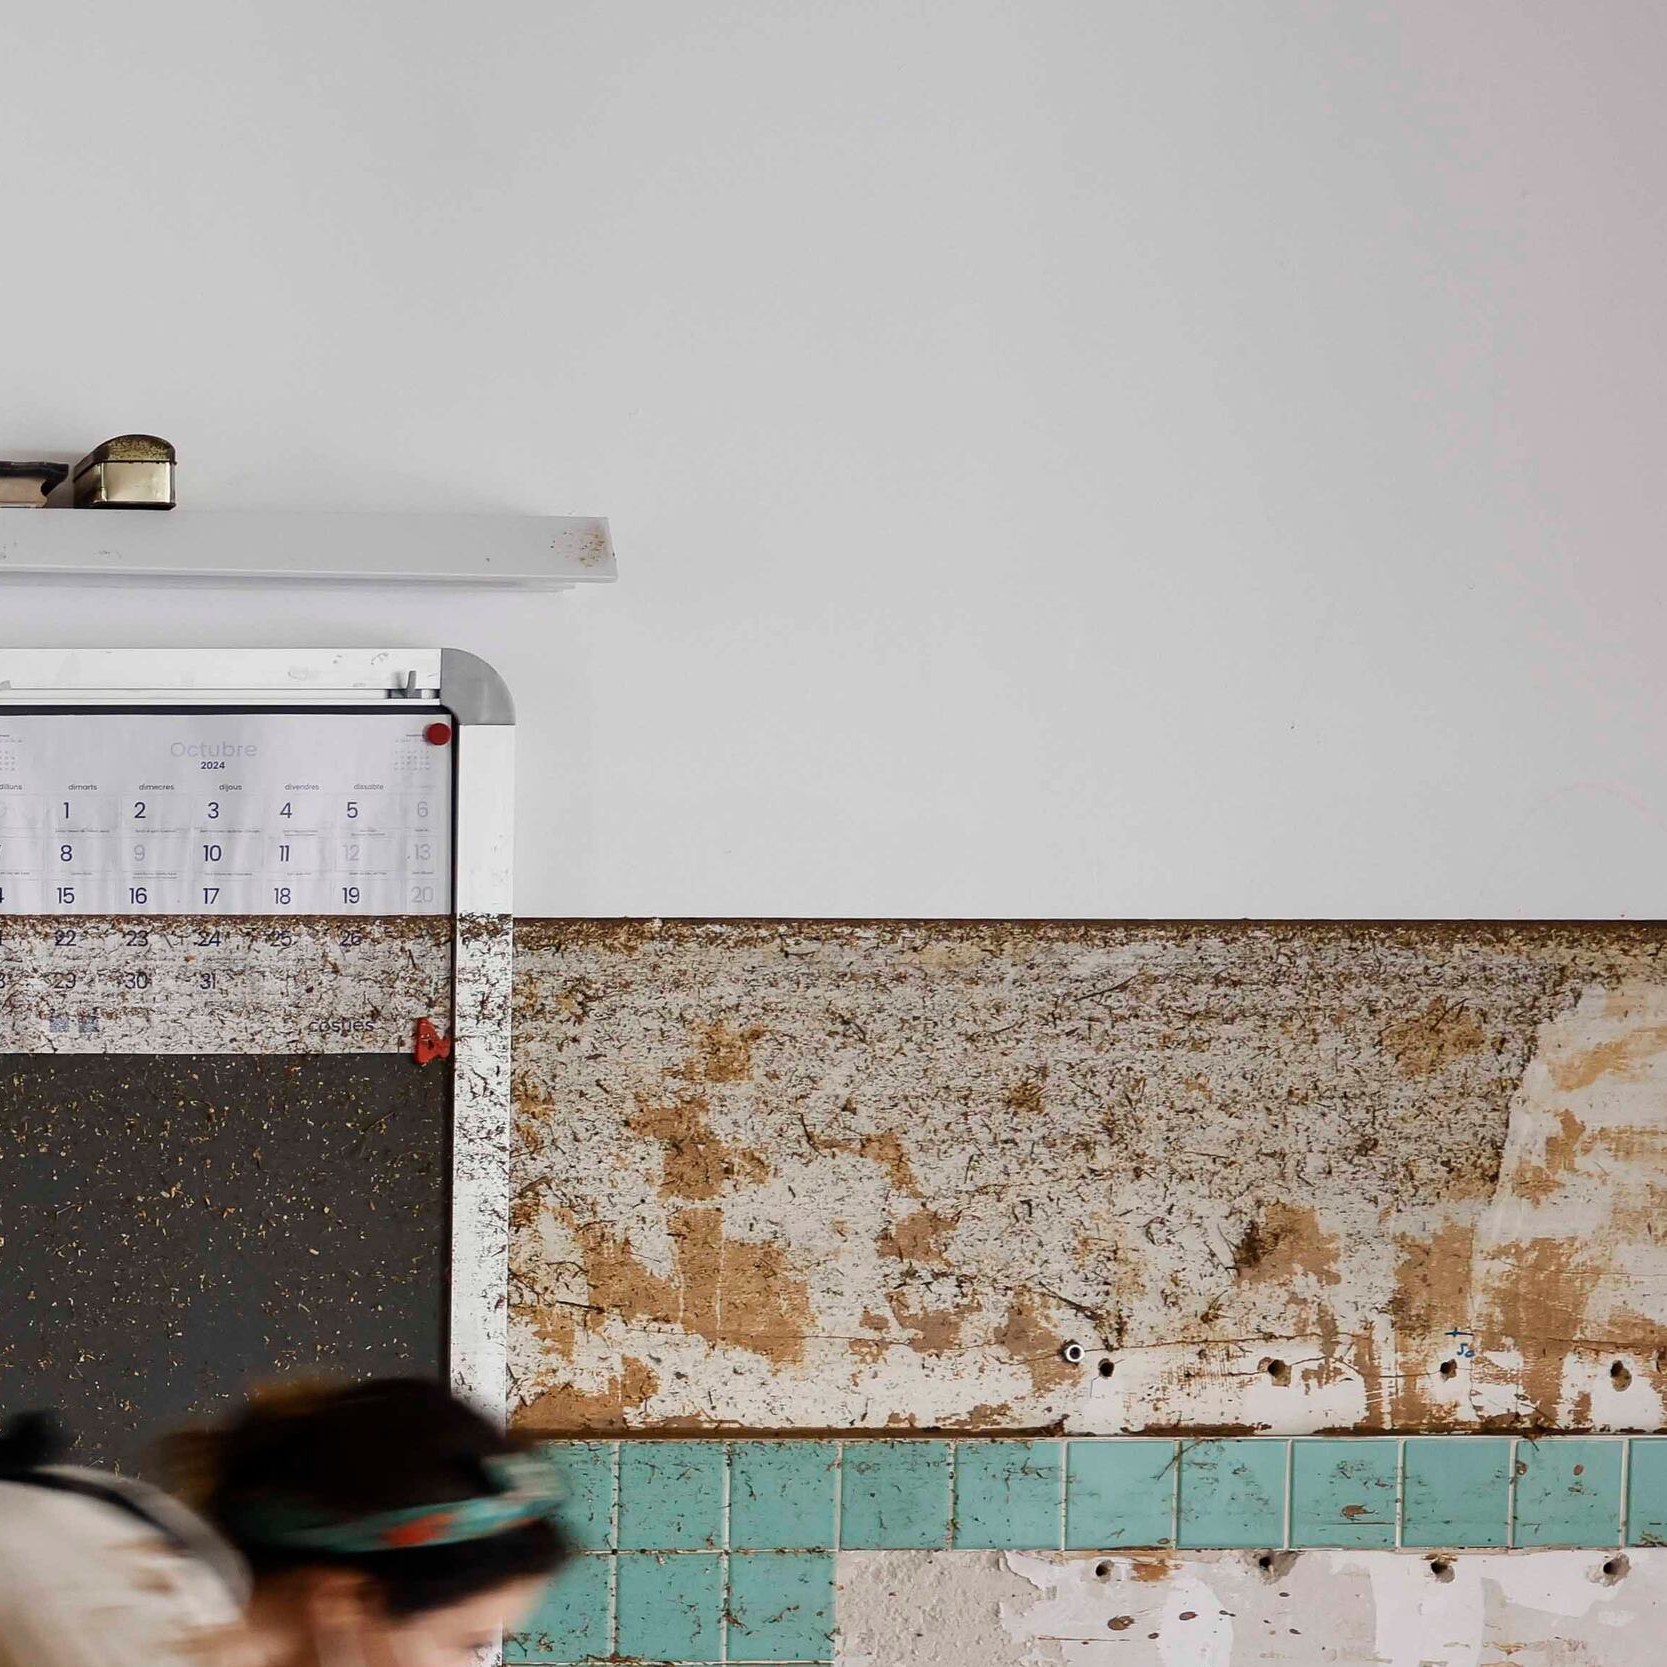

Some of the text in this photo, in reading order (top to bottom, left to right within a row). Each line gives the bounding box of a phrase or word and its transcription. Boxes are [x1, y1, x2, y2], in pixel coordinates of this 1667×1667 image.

[169, 740, 258, 758] Octubre
[200, 761, 226, 770] 2024
[68, 783, 98, 791] dimarts
[138, 783, 175, 791] dimecres
[218, 783, 243, 792] dijous
[284, 783, 320, 791] divendres
[353, 783, 384, 791] dissabte
[63, 802, 70, 819] 1
[134, 802, 146, 819] 2
[207, 802, 220, 819] 3
[279, 802, 293, 819] 4
[346, 801, 359, 819] 5
[416, 801, 429, 818] 6
[60, 844, 73, 862] 8
[133, 844, 146, 862] 9
[202, 844, 222, 862] 10
[279, 845, 290, 862] 11
[343, 844, 360, 861] 12
[415, 844, 431, 861] 13
[57, 887, 75, 904] 15
[129, 887, 148, 905] 16
[202, 887, 220, 904] 17
[273, 888, 291, 905] 18
[342, 887, 360, 904] 19
[411, 886, 434, 904] 20
[54, 929, 77, 947] 22
[125, 930, 149, 947] 23
[197, 931, 221, 947] 24
[269, 931, 292, 948] 25
[340, 930, 362, 947] 26
[53, 973, 77, 990] 29
[125, 972, 148, 990] 30
[199, 973, 216, 990] 31
